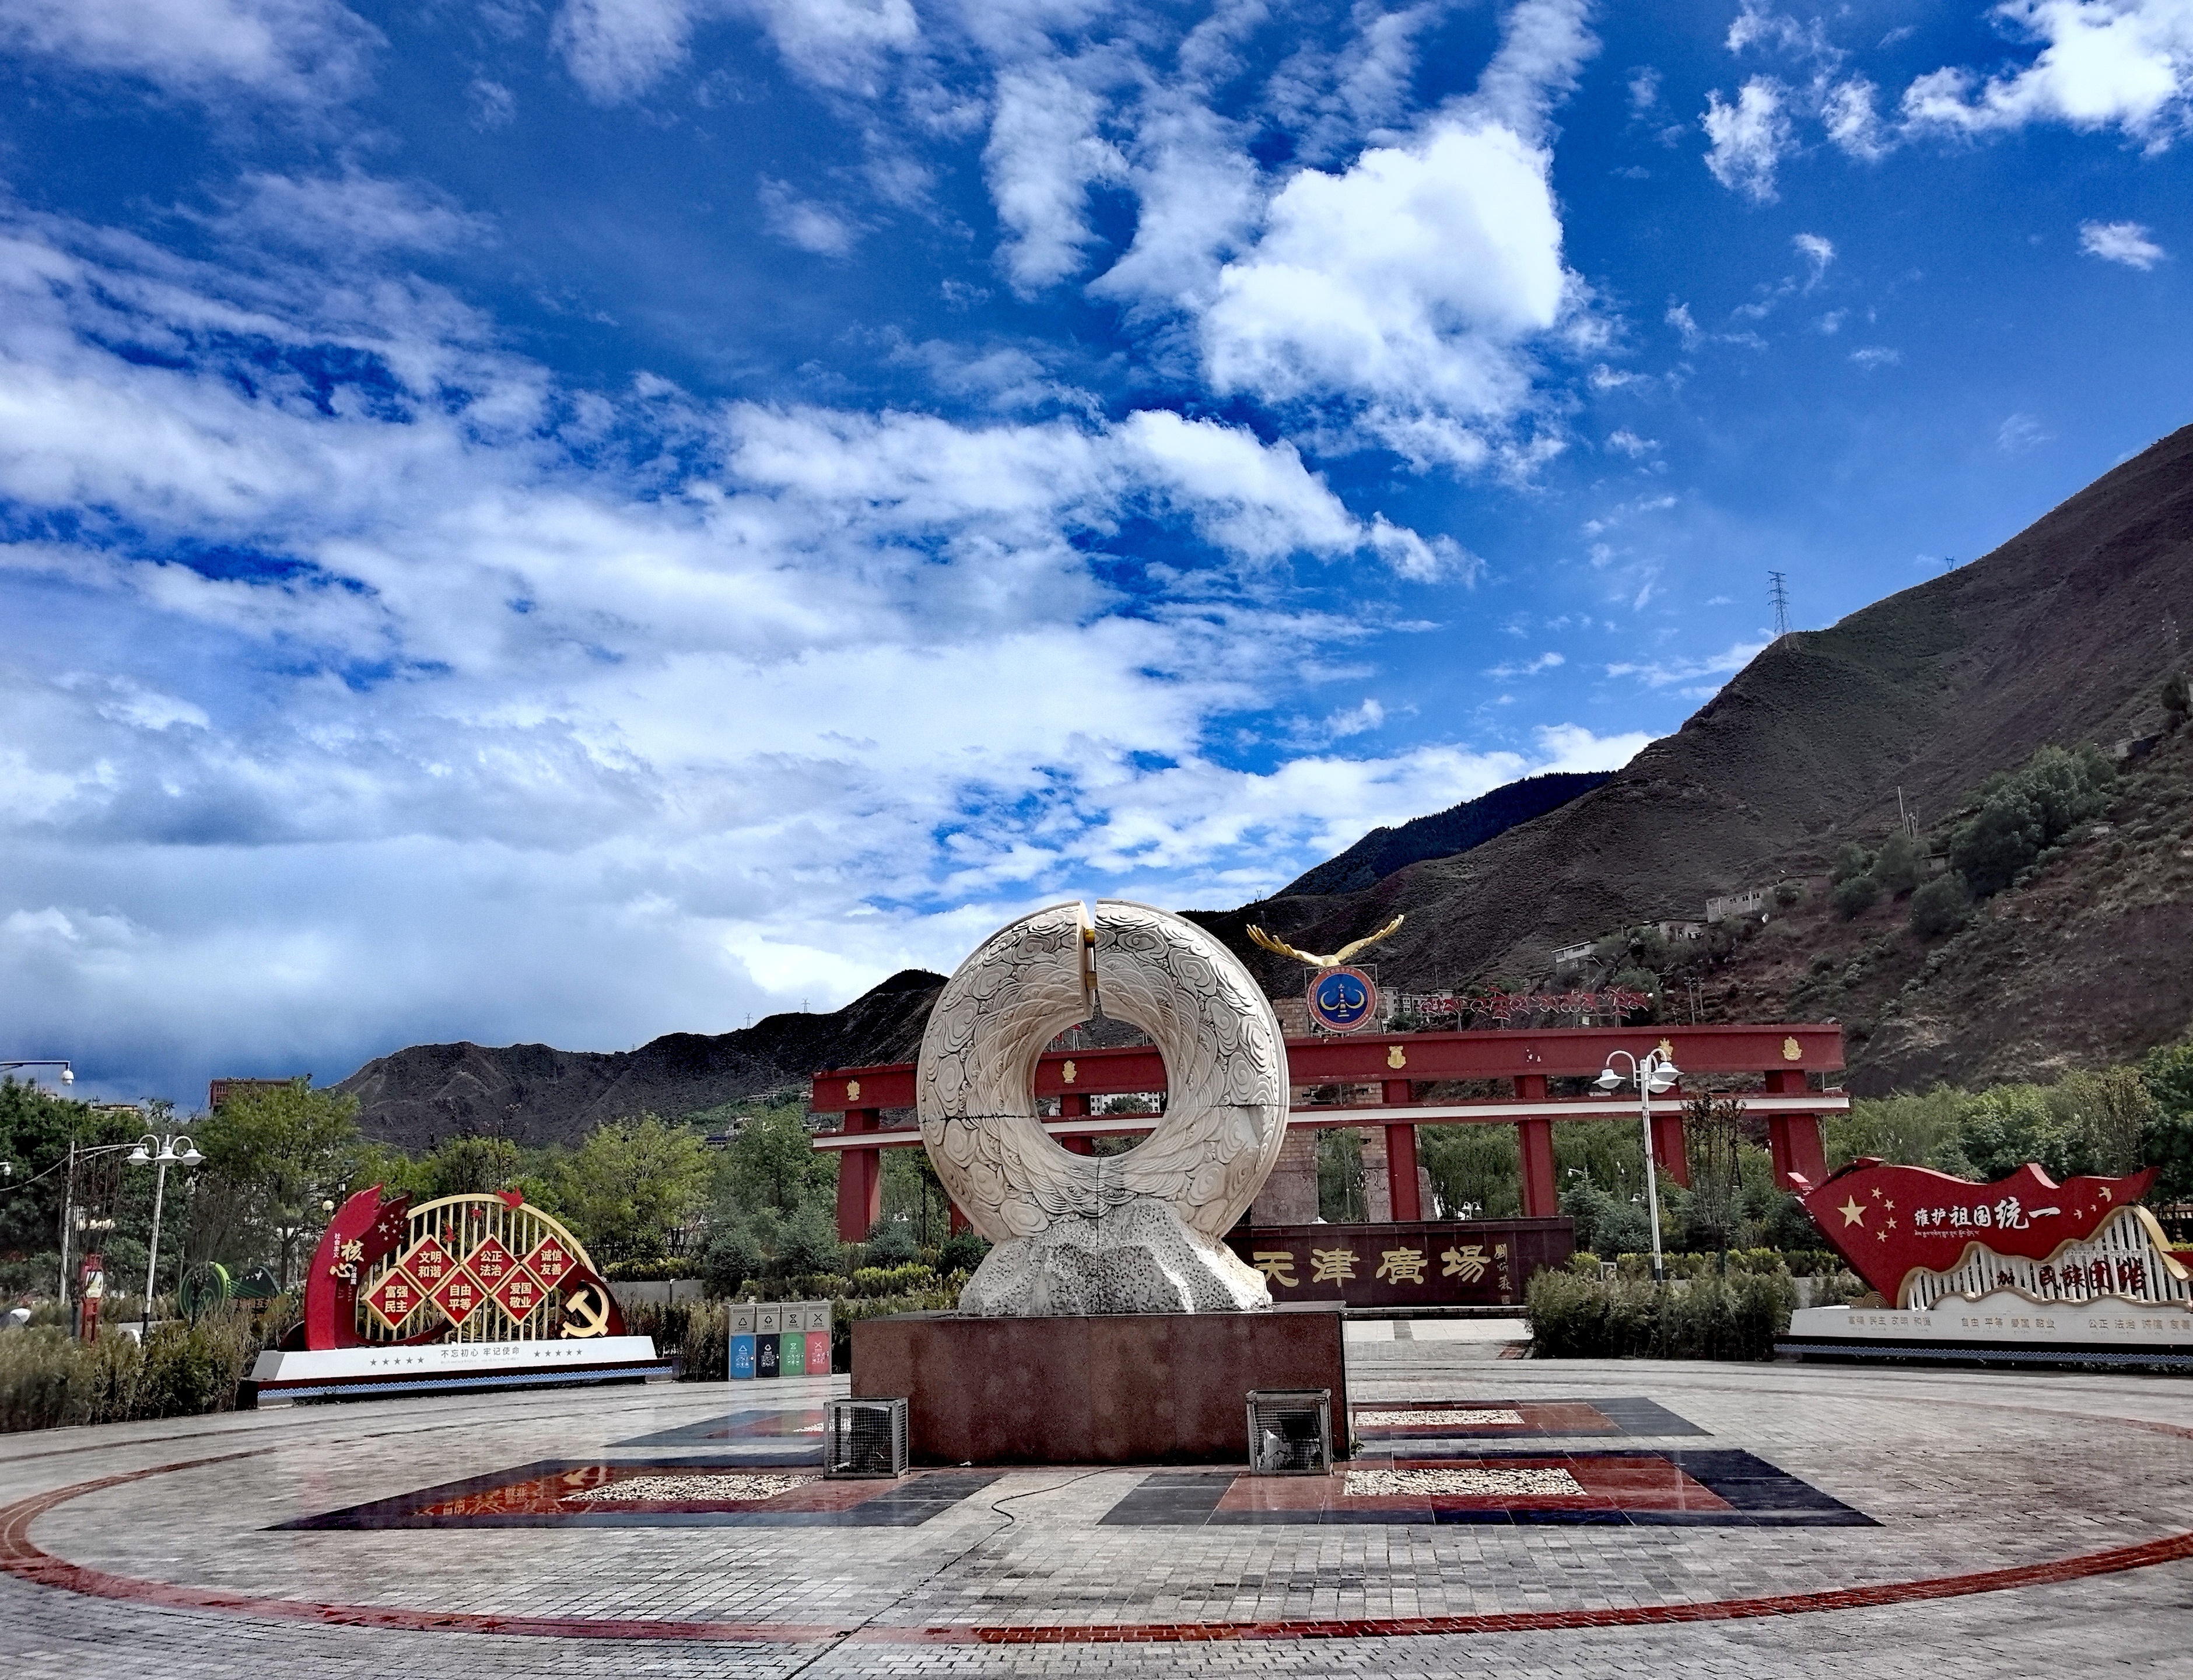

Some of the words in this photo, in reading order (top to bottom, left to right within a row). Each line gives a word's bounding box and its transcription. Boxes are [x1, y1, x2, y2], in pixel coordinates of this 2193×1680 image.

[1914, 1196, 2061, 1229] 维护祖国统一
[333, 1233, 341, 1258] 社会主义
[419, 1251, 442, 1264] 文明
[481, 1250, 503, 1262] 公正
[541, 1249, 563, 1262] 诚信
[418, 1265, 442, 1279] 和谐
[480, 1264, 502, 1276] 法治
[540, 1264, 562, 1275] 友善
[1253, 1245, 1491, 1288] 天津廣場
[385, 1285, 408, 1299] 富强
[450, 1283, 471, 1297] 自由
[509, 1282, 532, 1295] 爱国
[384, 1300, 408, 1313] 民主
[448, 1298, 471, 1311] 平等
[509, 1296, 532, 1309] 敬业
[1961, 1317, 1980, 1328] 自由
[2089, 1318, 2110, 1330] 公正
[441, 1348, 478, 1358] 不忘初心
[483, 1346, 520, 1356] 牢记使命
